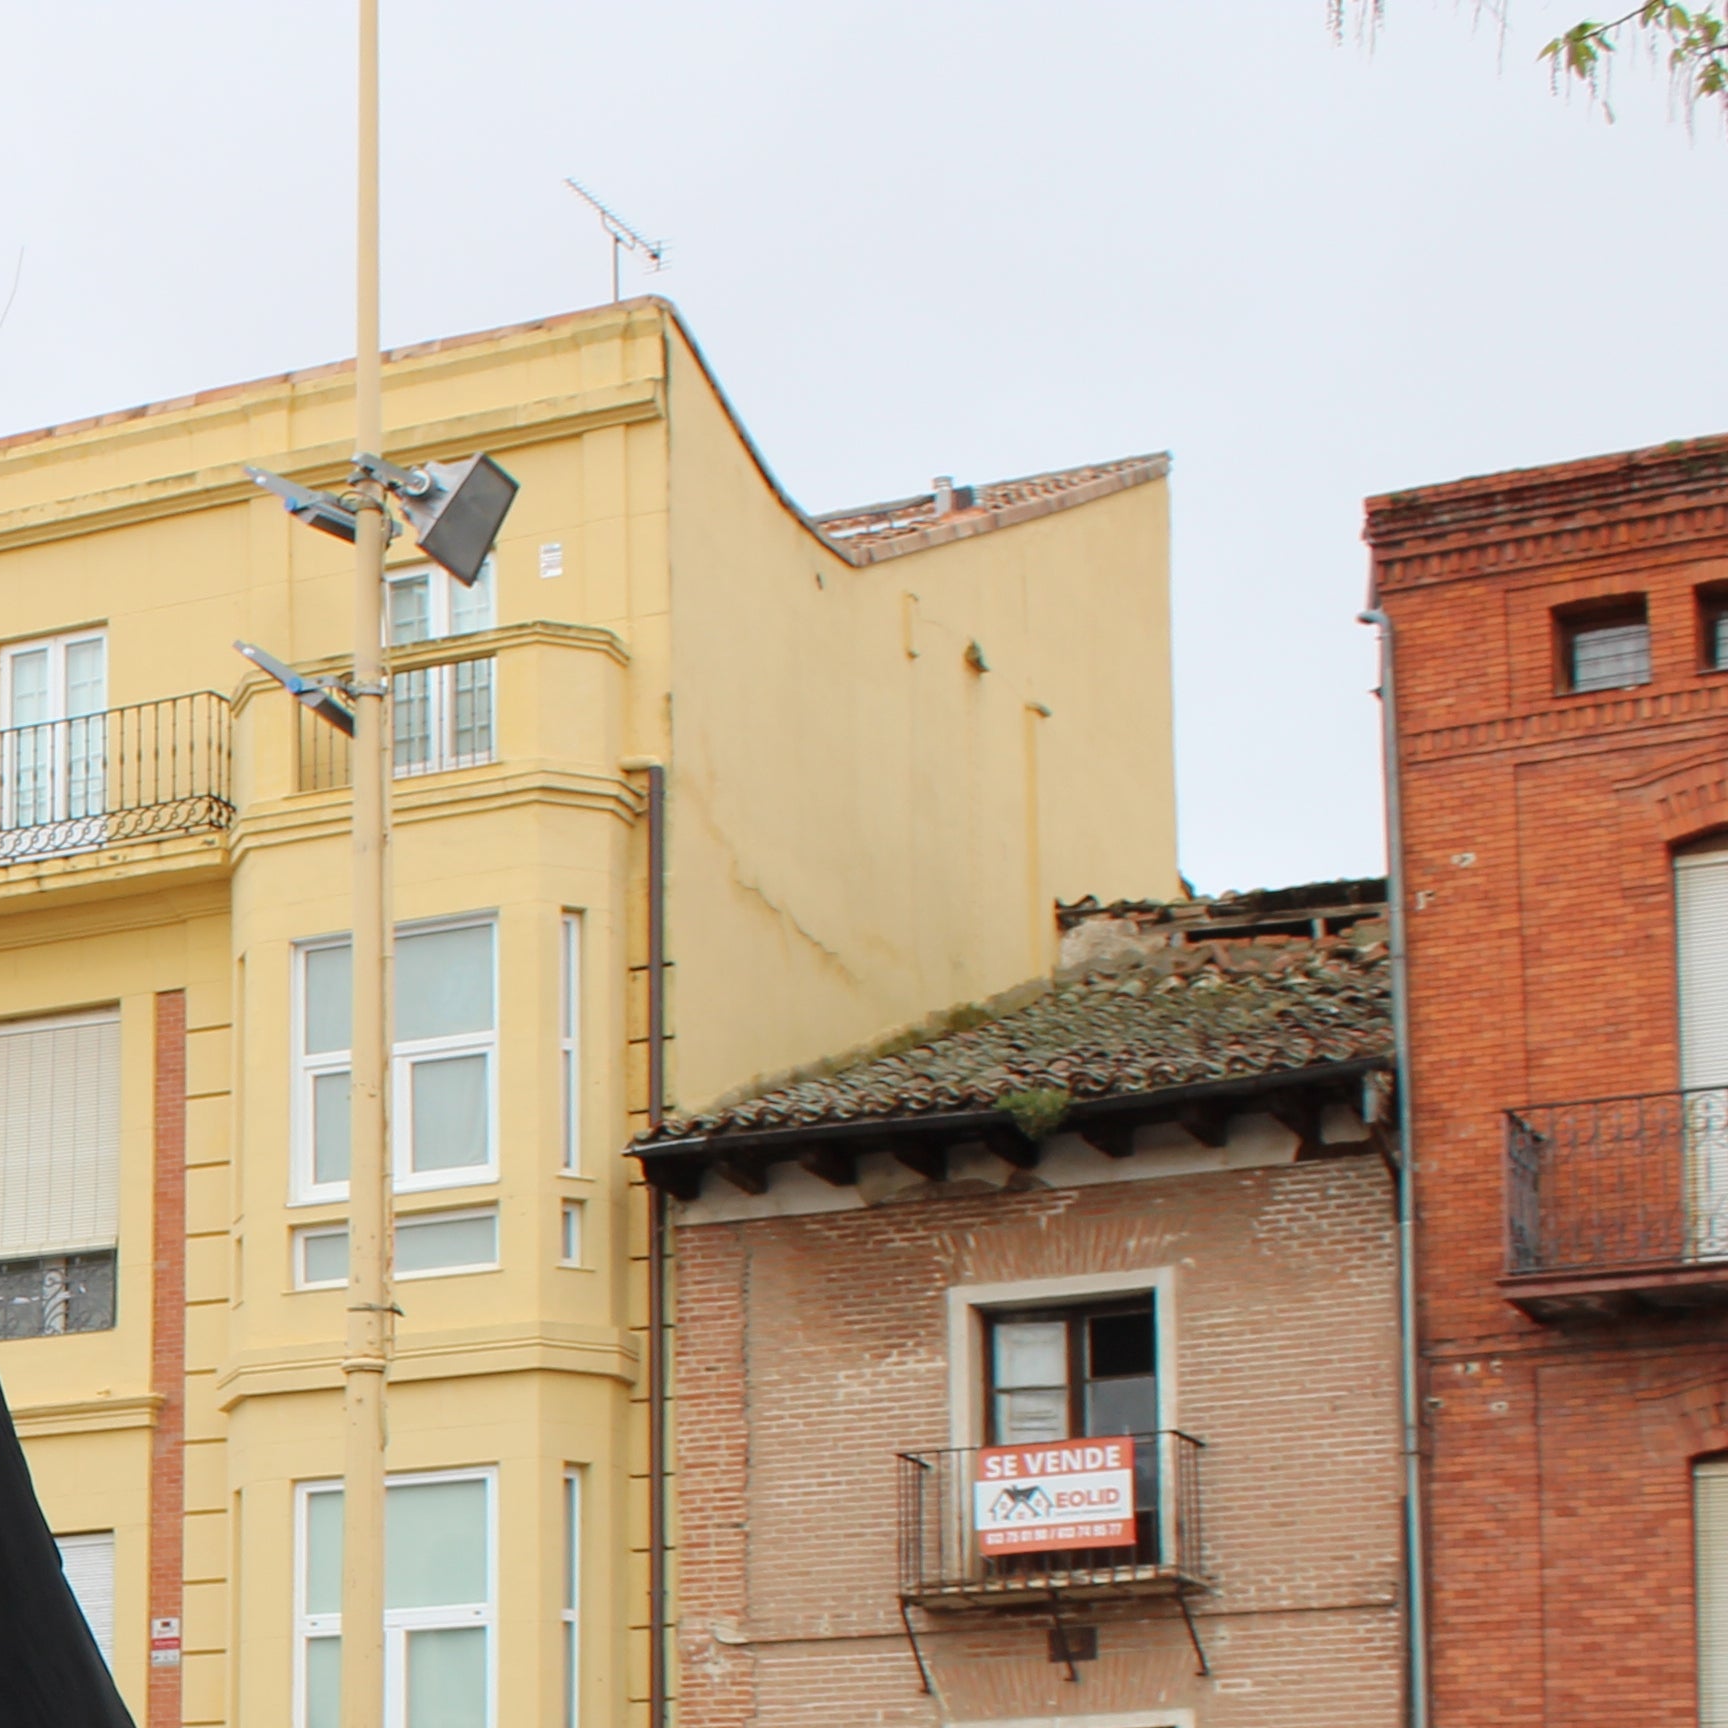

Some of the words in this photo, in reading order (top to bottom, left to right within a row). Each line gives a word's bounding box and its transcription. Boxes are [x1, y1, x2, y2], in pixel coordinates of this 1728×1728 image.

[985, 1454, 1018, 1478] SE
[1024, 1445, 1121, 1475] VENDE
[1055, 1488, 1120, 1509] EOLID
